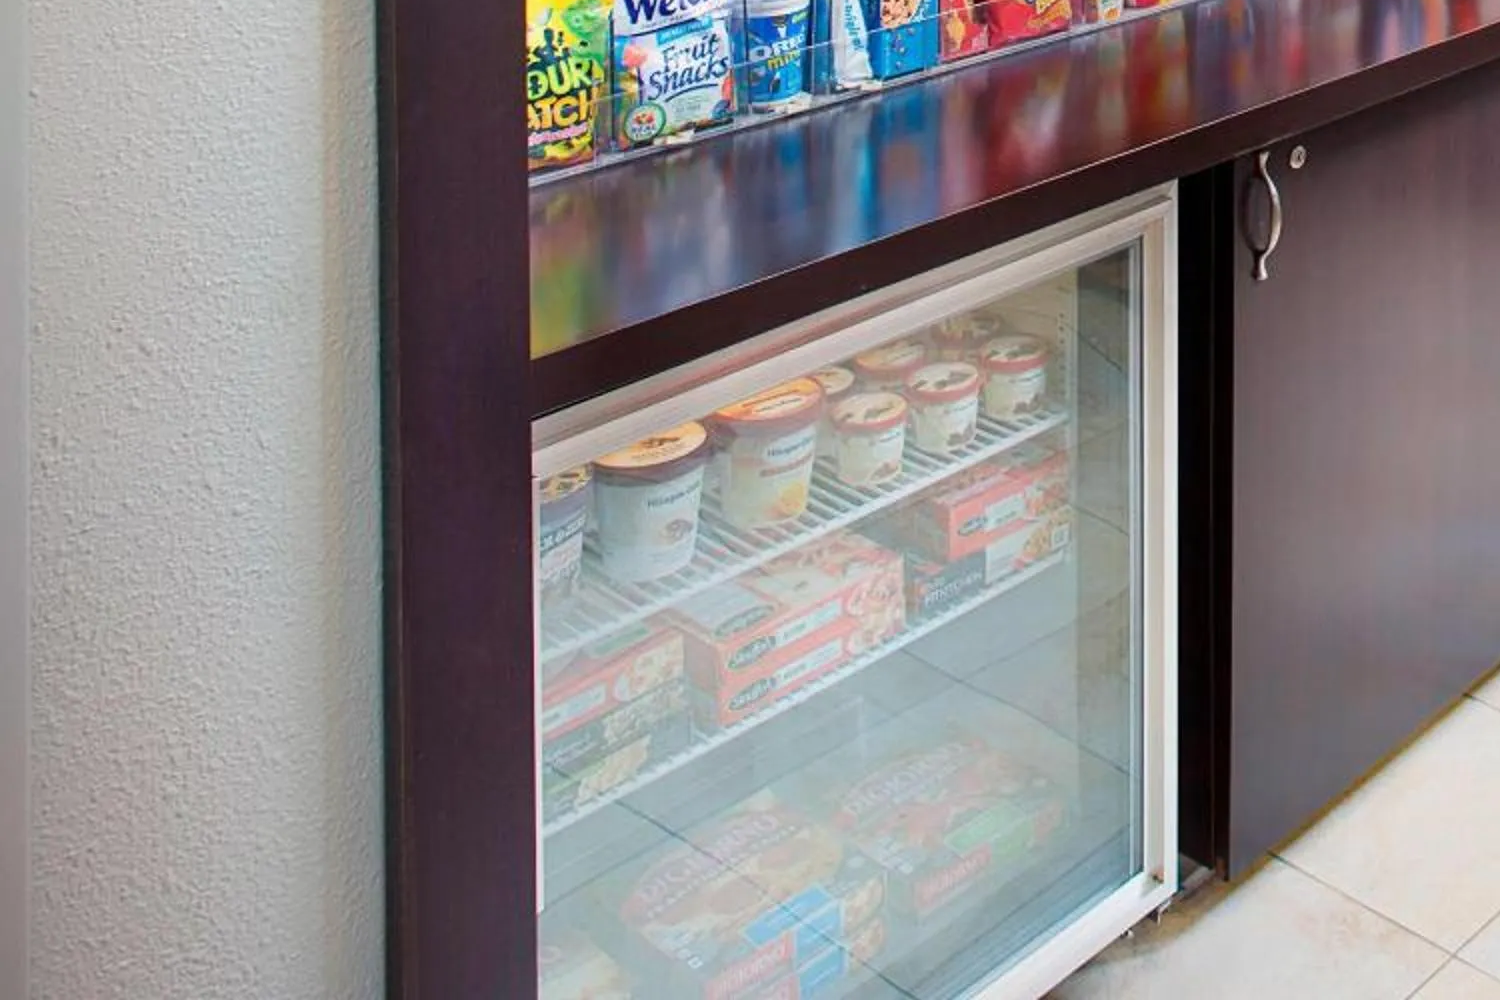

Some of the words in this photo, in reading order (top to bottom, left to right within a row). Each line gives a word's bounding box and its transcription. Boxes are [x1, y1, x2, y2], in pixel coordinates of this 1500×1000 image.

[661, 33, 720, 72] Fruit
[527, 57, 593, 101] OUR
[648, 55, 731, 101] Snacks
[527, 88, 598, 129] ATCH
